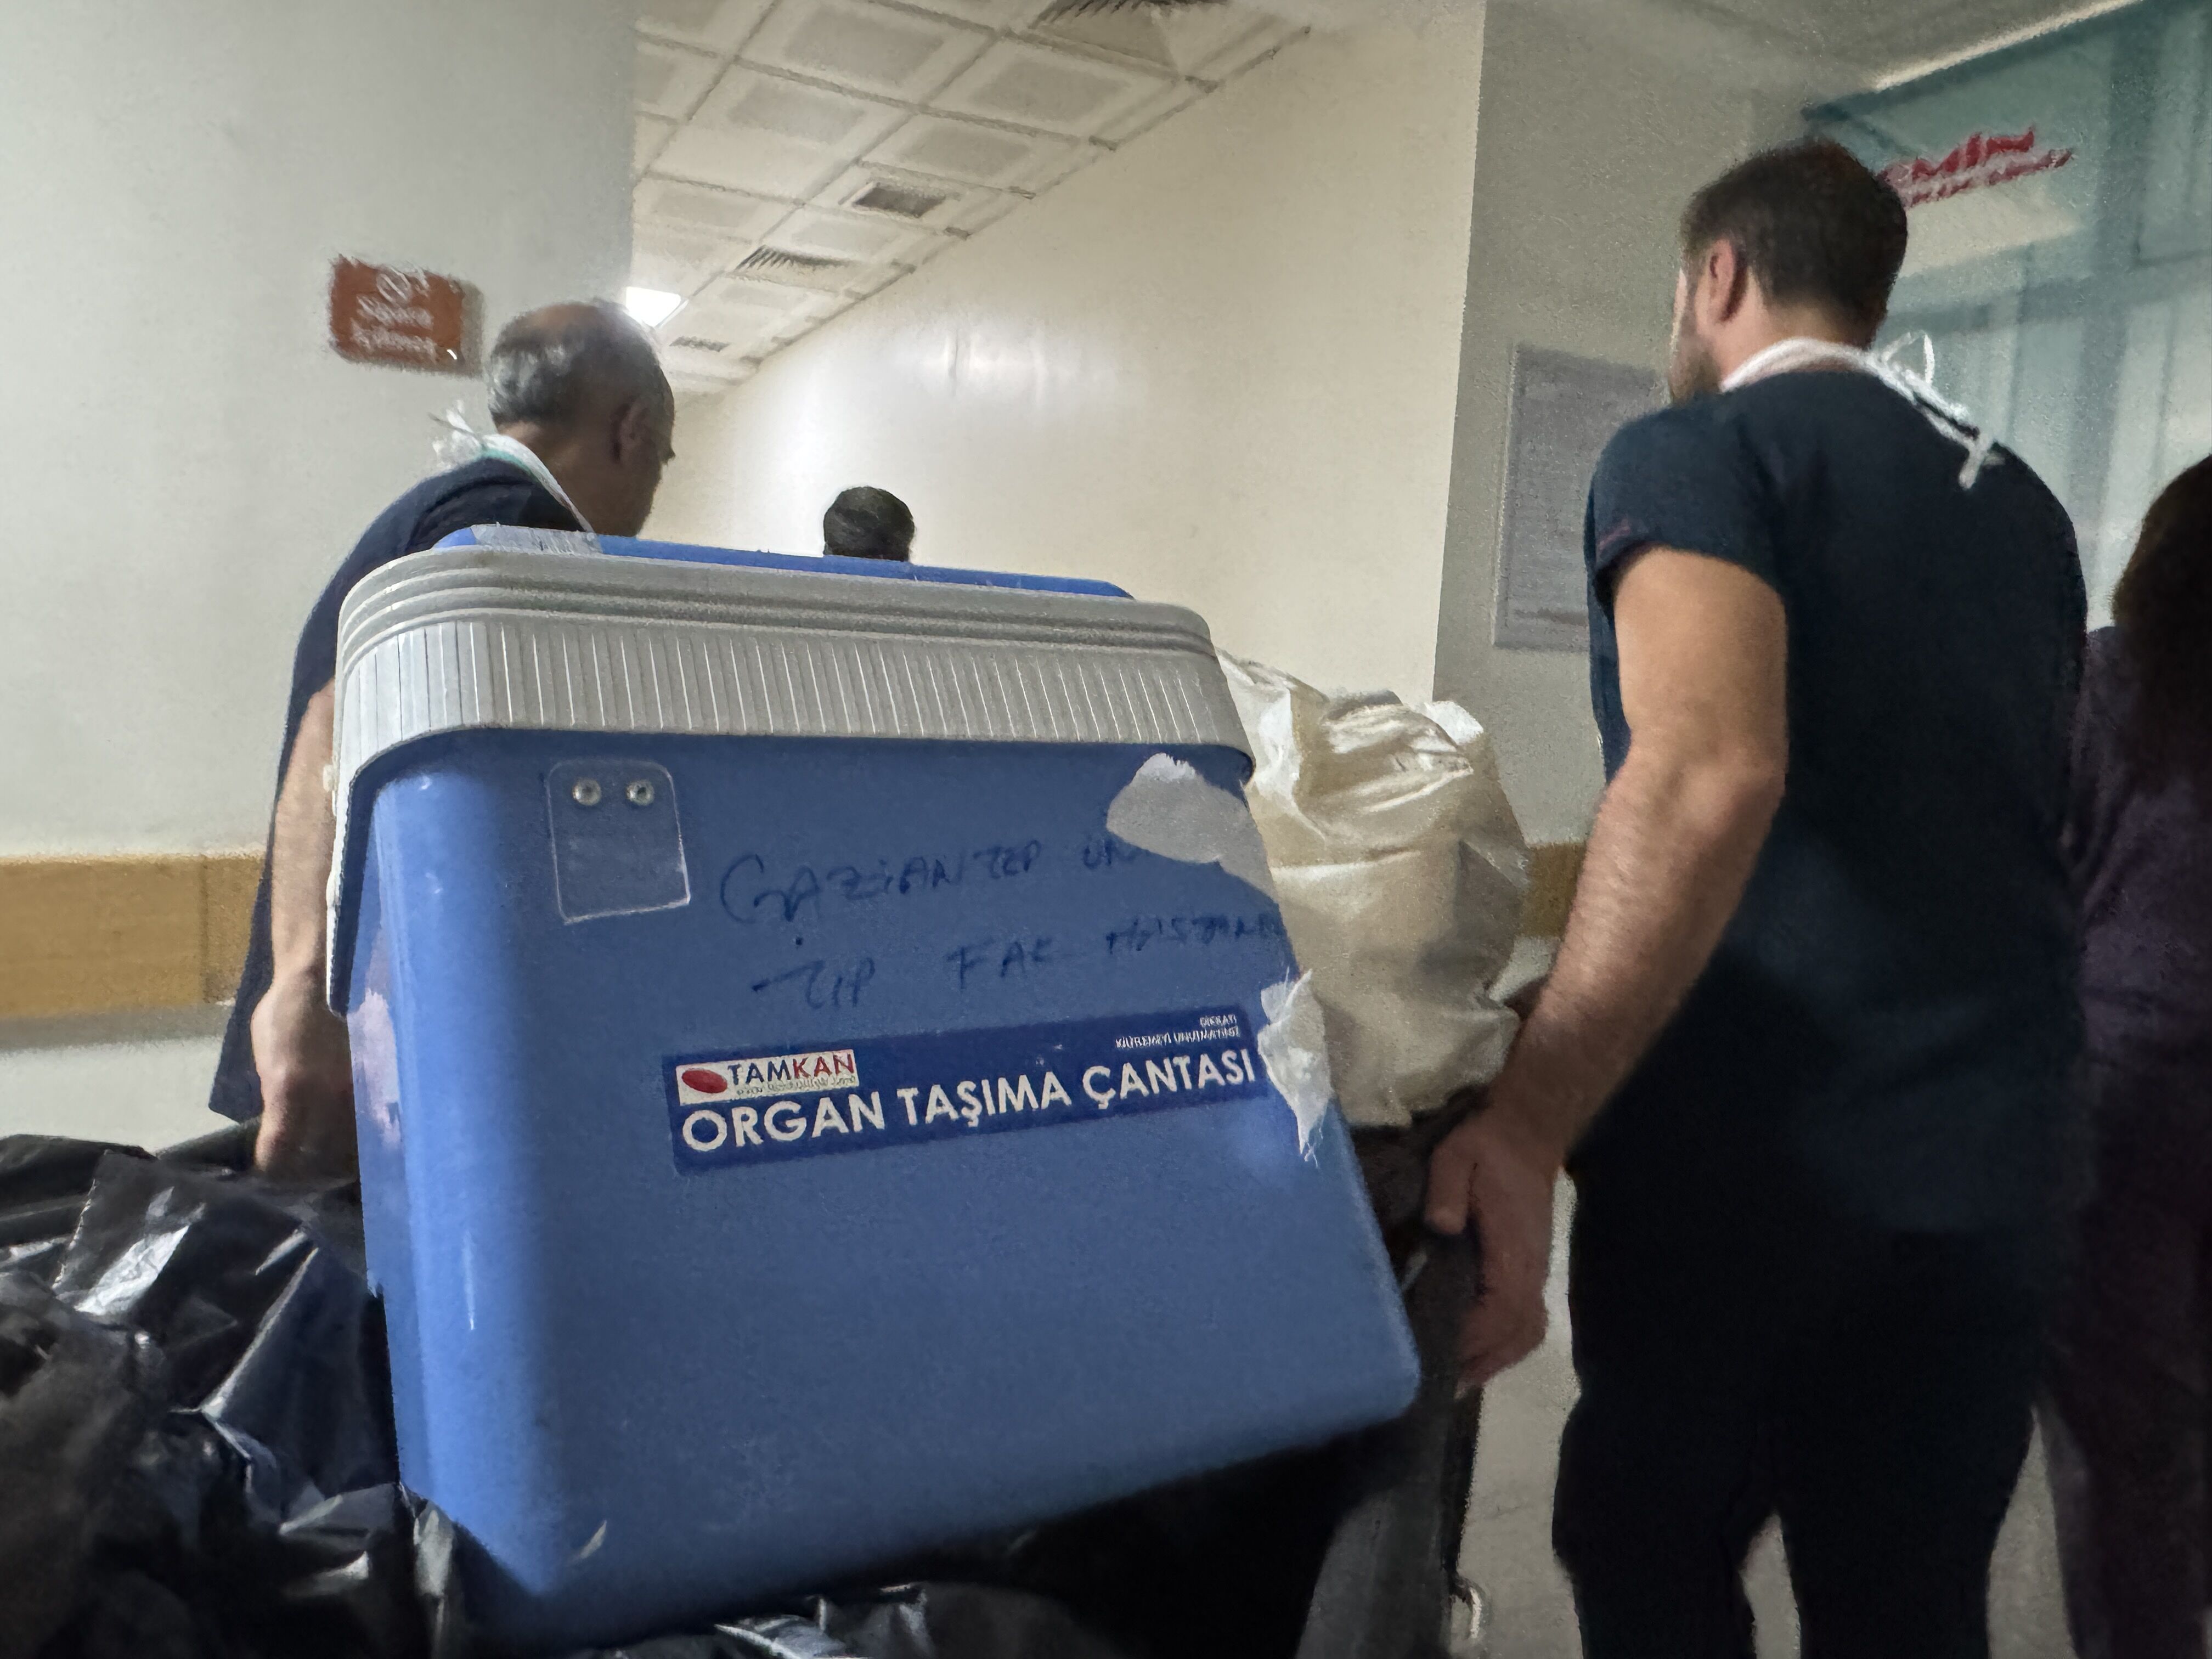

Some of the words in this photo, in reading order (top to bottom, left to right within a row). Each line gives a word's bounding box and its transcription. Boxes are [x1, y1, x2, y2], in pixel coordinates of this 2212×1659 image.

[682, 1091, 885, 1152] ORGAN
[896, 1071, 1072, 1127] TAŞIMA
[1082, 1048, 1256, 1109] ÇANTASI
[727, 1053, 855, 1085] TAMKAN
